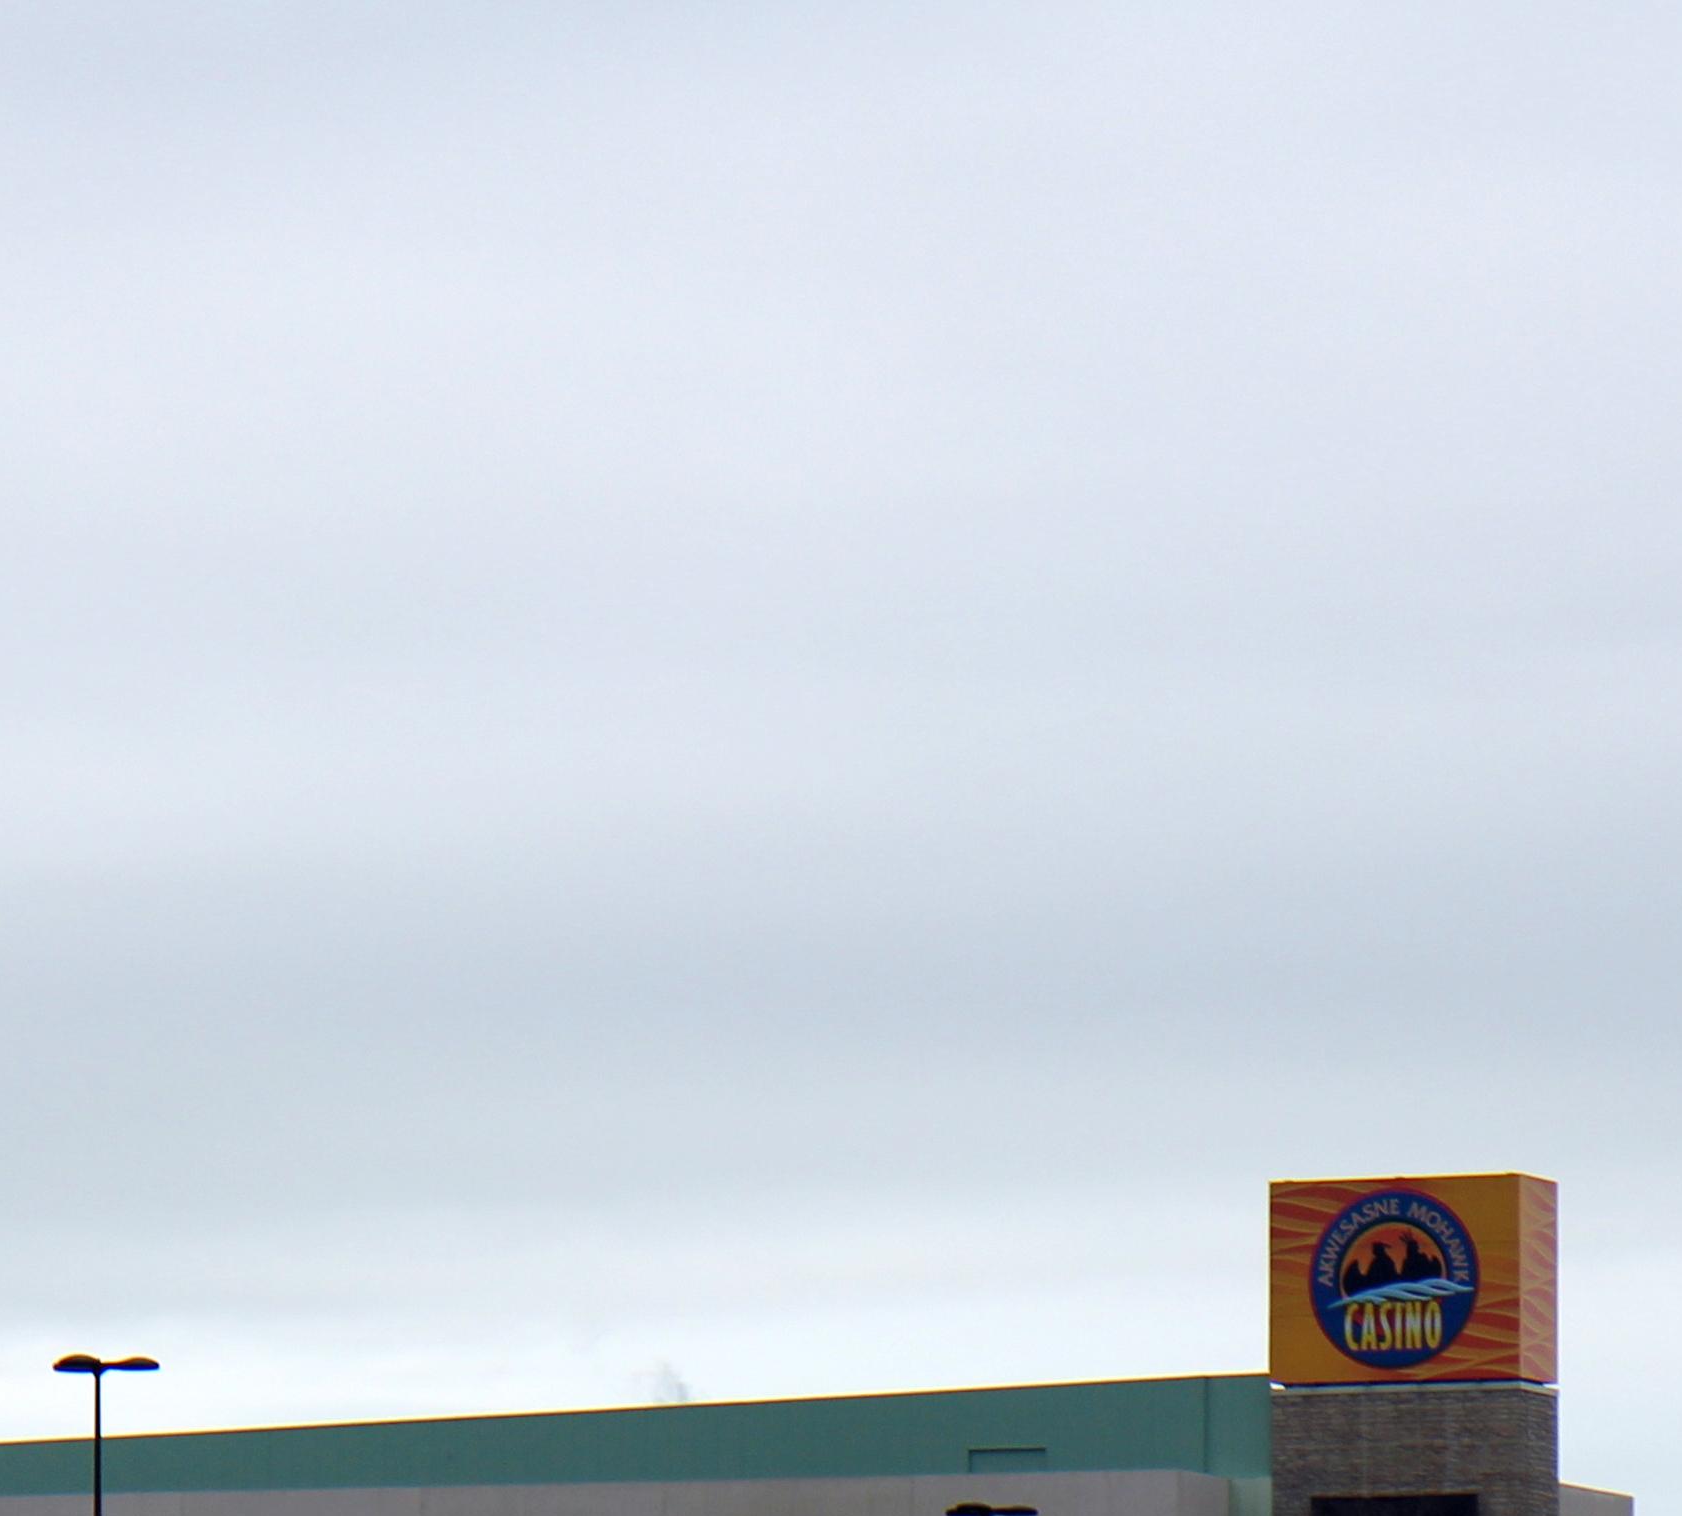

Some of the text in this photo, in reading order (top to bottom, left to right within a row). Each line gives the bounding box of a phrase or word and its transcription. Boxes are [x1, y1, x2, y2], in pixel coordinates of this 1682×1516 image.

[1318, 1199, 1469, 1287] AKWESASNE MOHAWK
[1344, 1302, 1442, 1350] CASINO
